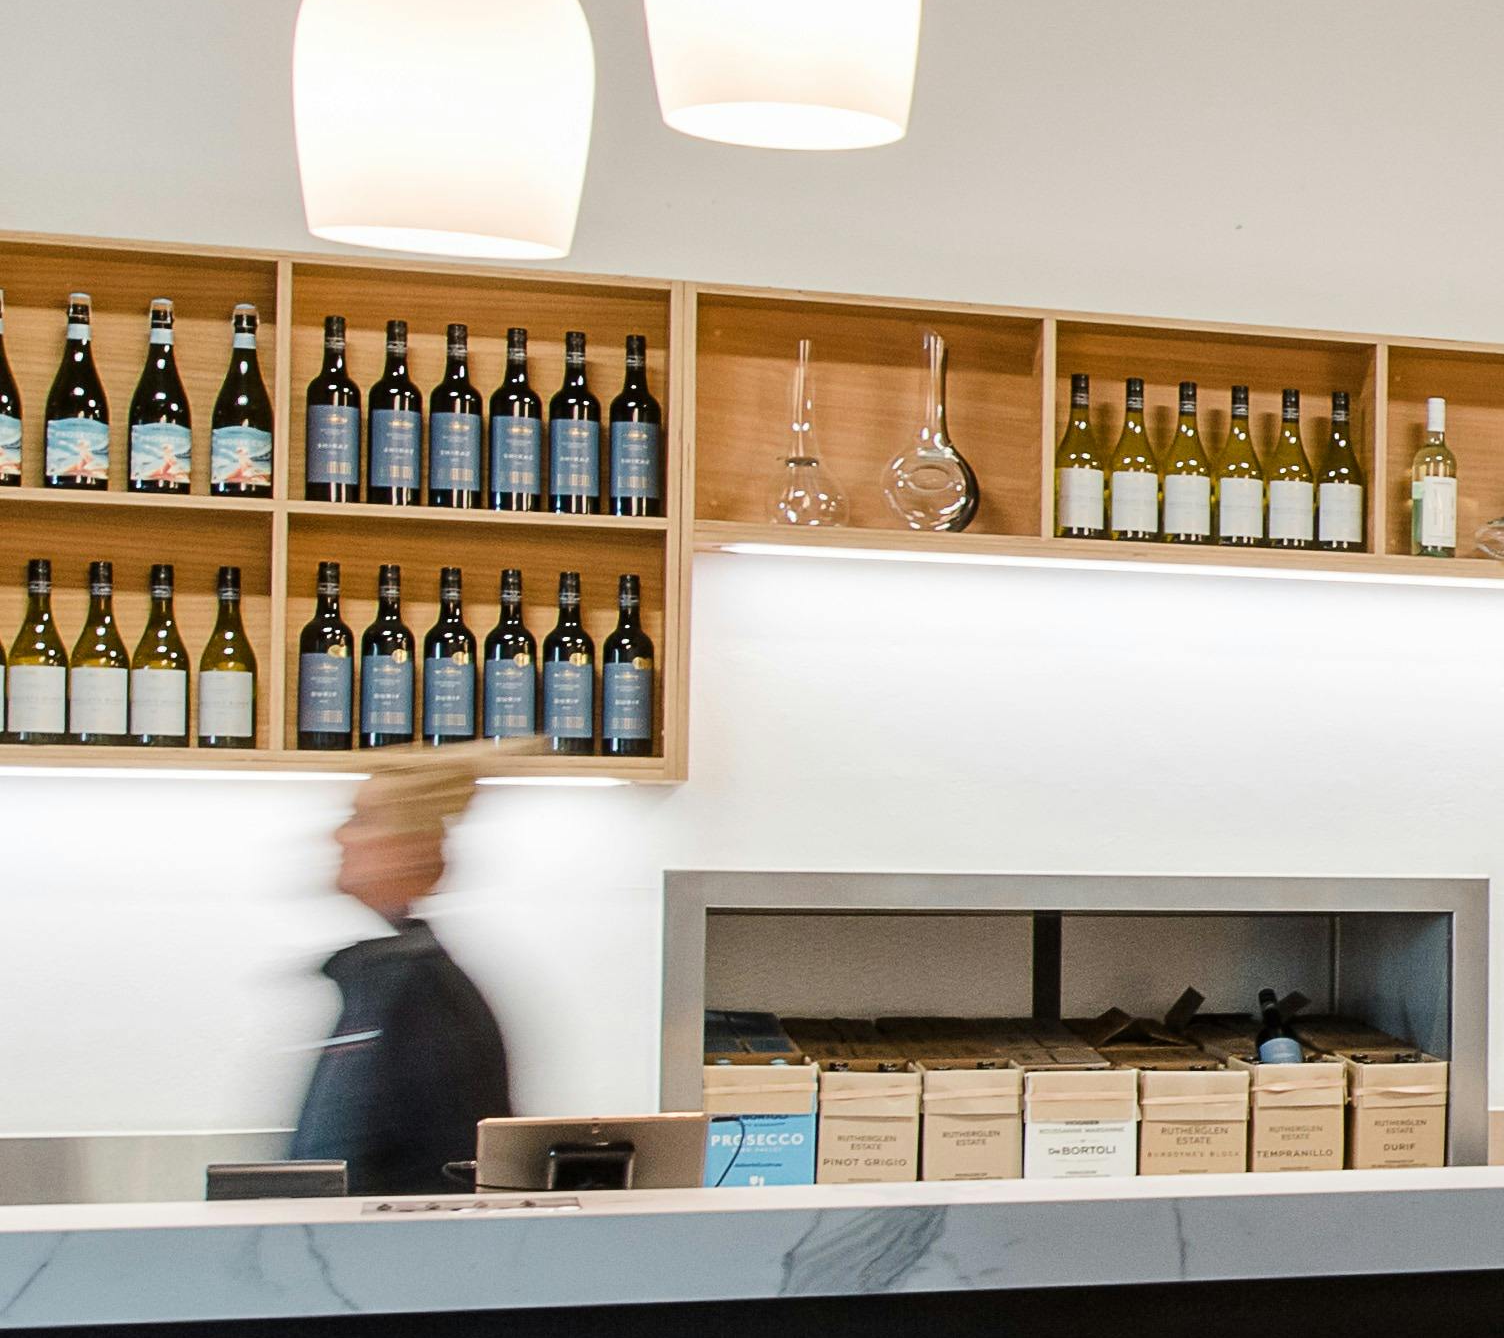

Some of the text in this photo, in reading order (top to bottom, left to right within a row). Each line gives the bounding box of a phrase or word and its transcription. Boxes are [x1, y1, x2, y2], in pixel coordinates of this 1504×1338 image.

[1374, 1119, 1428, 1128] RUTHERGLEN
[941, 1129, 1001, 1139] RUTHERGLEN
[1160, 1126, 1230, 1135] RUTHERGLEN
[1268, 1125, 1324, 1134] RUTHERGLEN
[1385, 1127, 1414, 1135] ESTATE
[710, 1132, 805, 1147] PROSECCO
[836, 1134, 897, 1143] RUTHERGLEN
[1175, 1136, 1213, 1145] ESTATE
[1281, 1133, 1311, 1141] ESTATE
[850, 1142, 882, 1151] ESTATE
[955, 1138, 987, 1147] ESTATE
[1382, 1142, 1417, 1152] DURIF
[1256, 1148, 1334, 1159] TEMPRANILLO
[822, 1157, 908, 1167] PINOT GRIGIO
